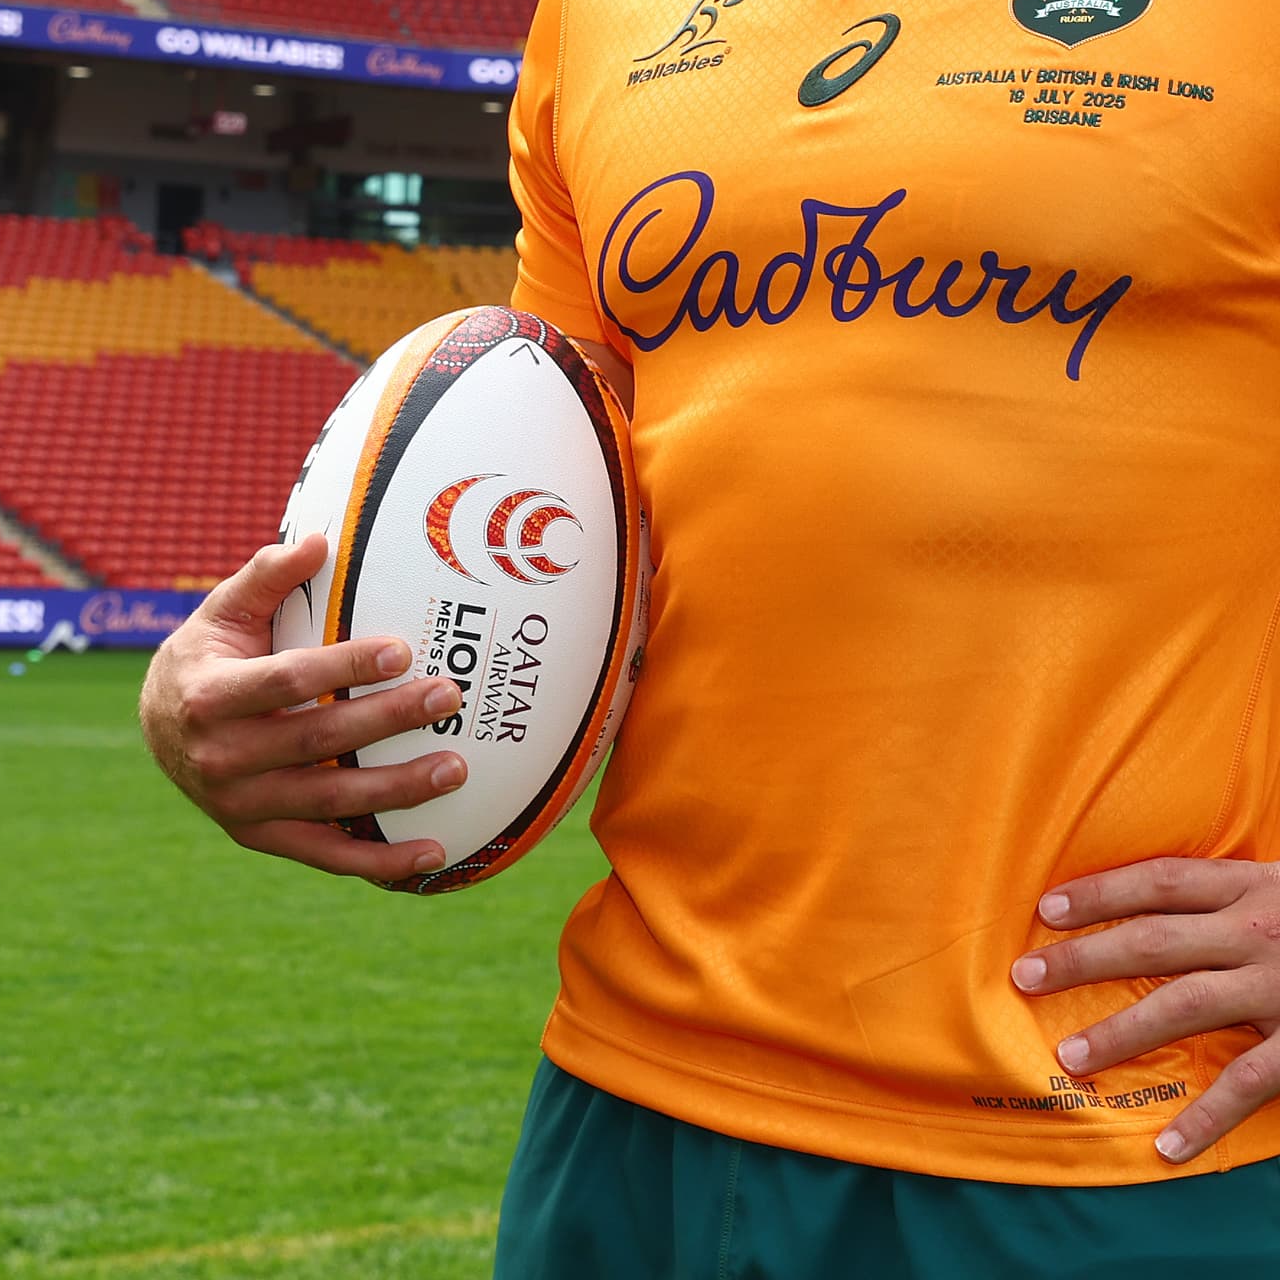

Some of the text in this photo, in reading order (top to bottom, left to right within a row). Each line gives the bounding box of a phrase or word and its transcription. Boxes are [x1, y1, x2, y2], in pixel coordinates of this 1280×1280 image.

[1046, 0, 1112, 12] AUSTRALIA
[1060, 15, 1094, 23] RUGBY
[626, 53, 725, 87] Wallabies
[936, 70, 1016, 86] AUSTRALIA
[1036, 69, 1095, 85] BRITISH
[1101, 72, 1114, 87] &
[1118, 73, 1159, 91] IRISH
[1168, 79, 1214, 102] LIONS
[1033, 89, 1073, 104] JULY
[1082, 92, 1126, 109] 2025
[1023, 108, 1101, 127] BRISBANE
[598, 170, 1132, 381] Cadbury
[432, 604, 486, 735] LIOS
[496, 614, 548, 743] QATAR
[475, 642, 511, 741] AIRWAYS
[1009, 1094, 1084, 1111] CHAMPION
[1087, 1095, 1104, 1107] DE
[1108, 1081, 1188, 1109] CRESPIGNY
[1050, 1076, 1097, 1094] DEBUT
